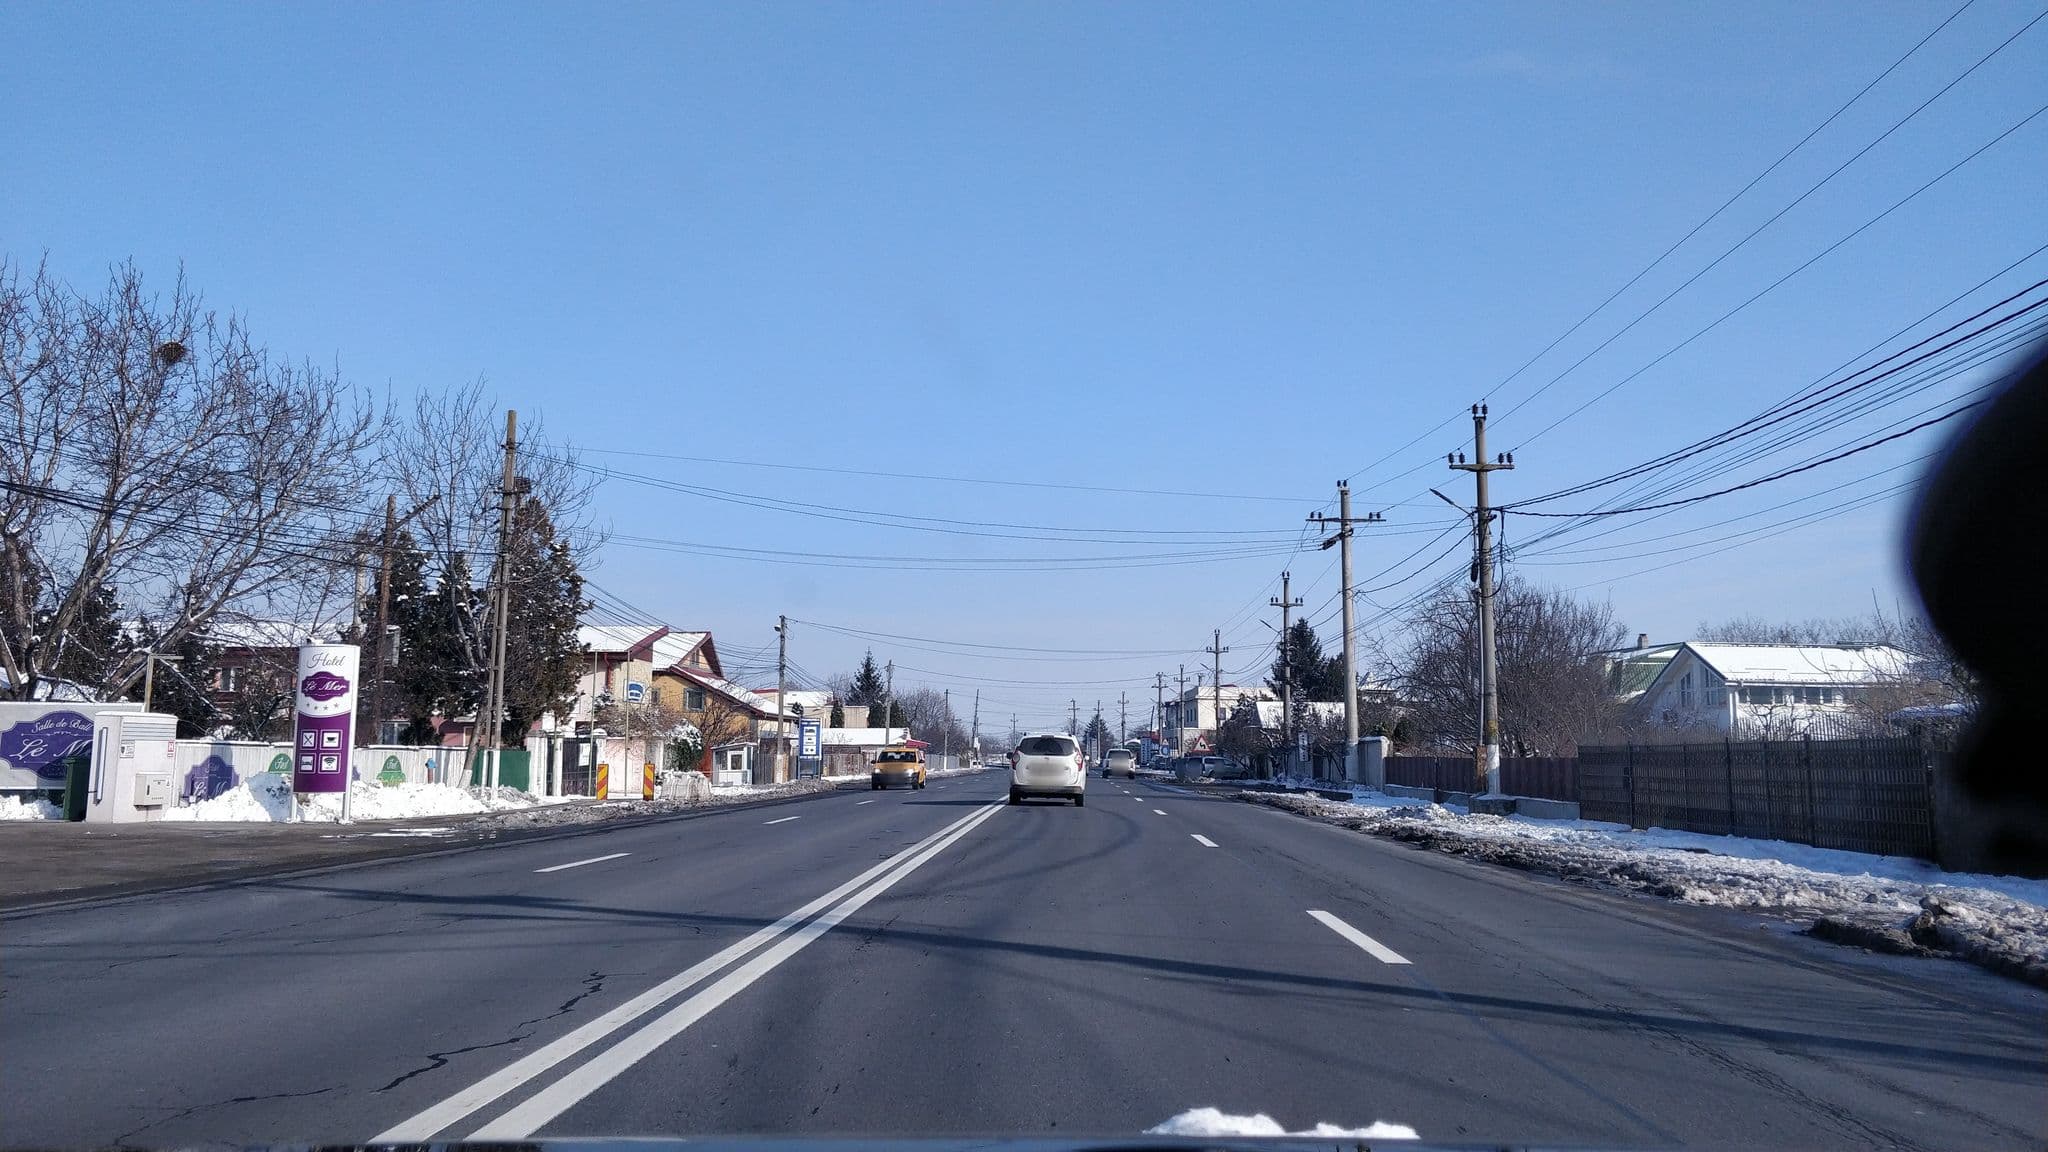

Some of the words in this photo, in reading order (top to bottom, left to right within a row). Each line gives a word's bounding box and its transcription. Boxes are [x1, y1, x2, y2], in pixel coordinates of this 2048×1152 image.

[308, 652, 346, 668] Hotel
[319, 680, 346, 691] Mer
[31, 719, 54, 733] Salle
[55, 718, 68, 728] de
